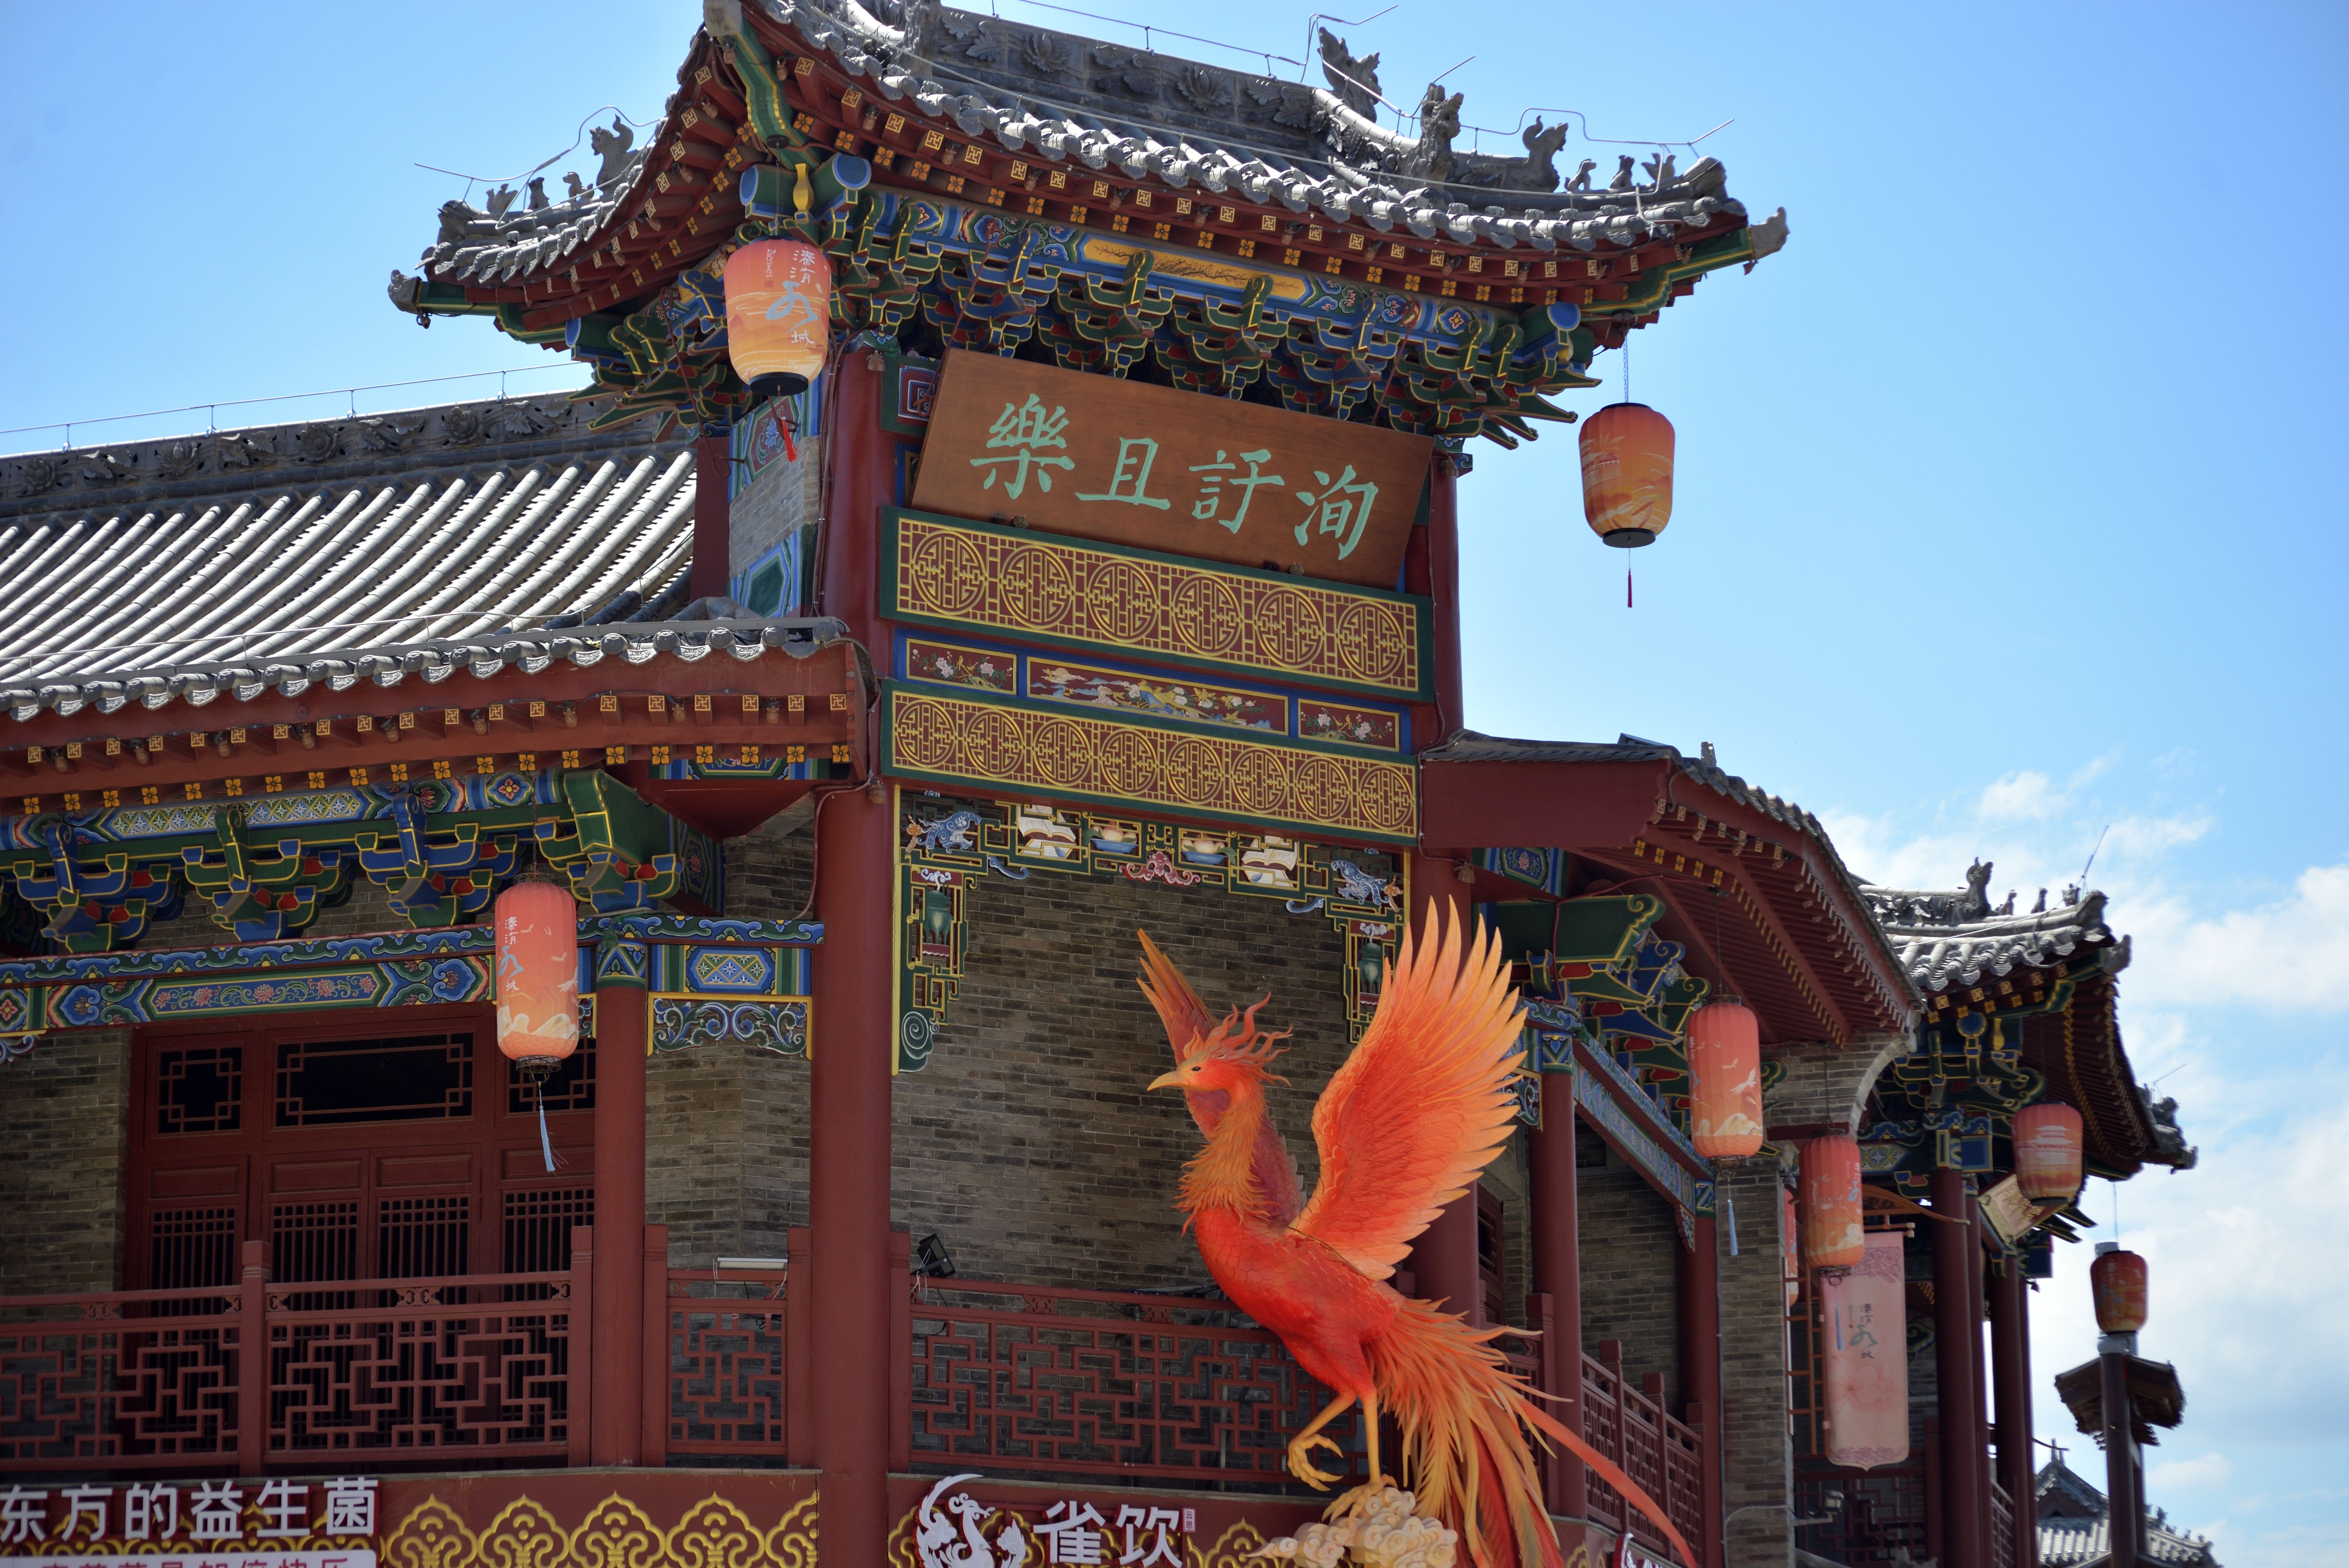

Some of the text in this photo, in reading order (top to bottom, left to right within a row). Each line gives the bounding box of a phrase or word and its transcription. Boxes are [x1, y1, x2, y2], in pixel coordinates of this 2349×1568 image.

[766, 249, 776, 278] Zhenwei
[0, 1477, 378, 1543] 东方的益生菌
[1033, 1500, 1182, 1568] 雀饮
